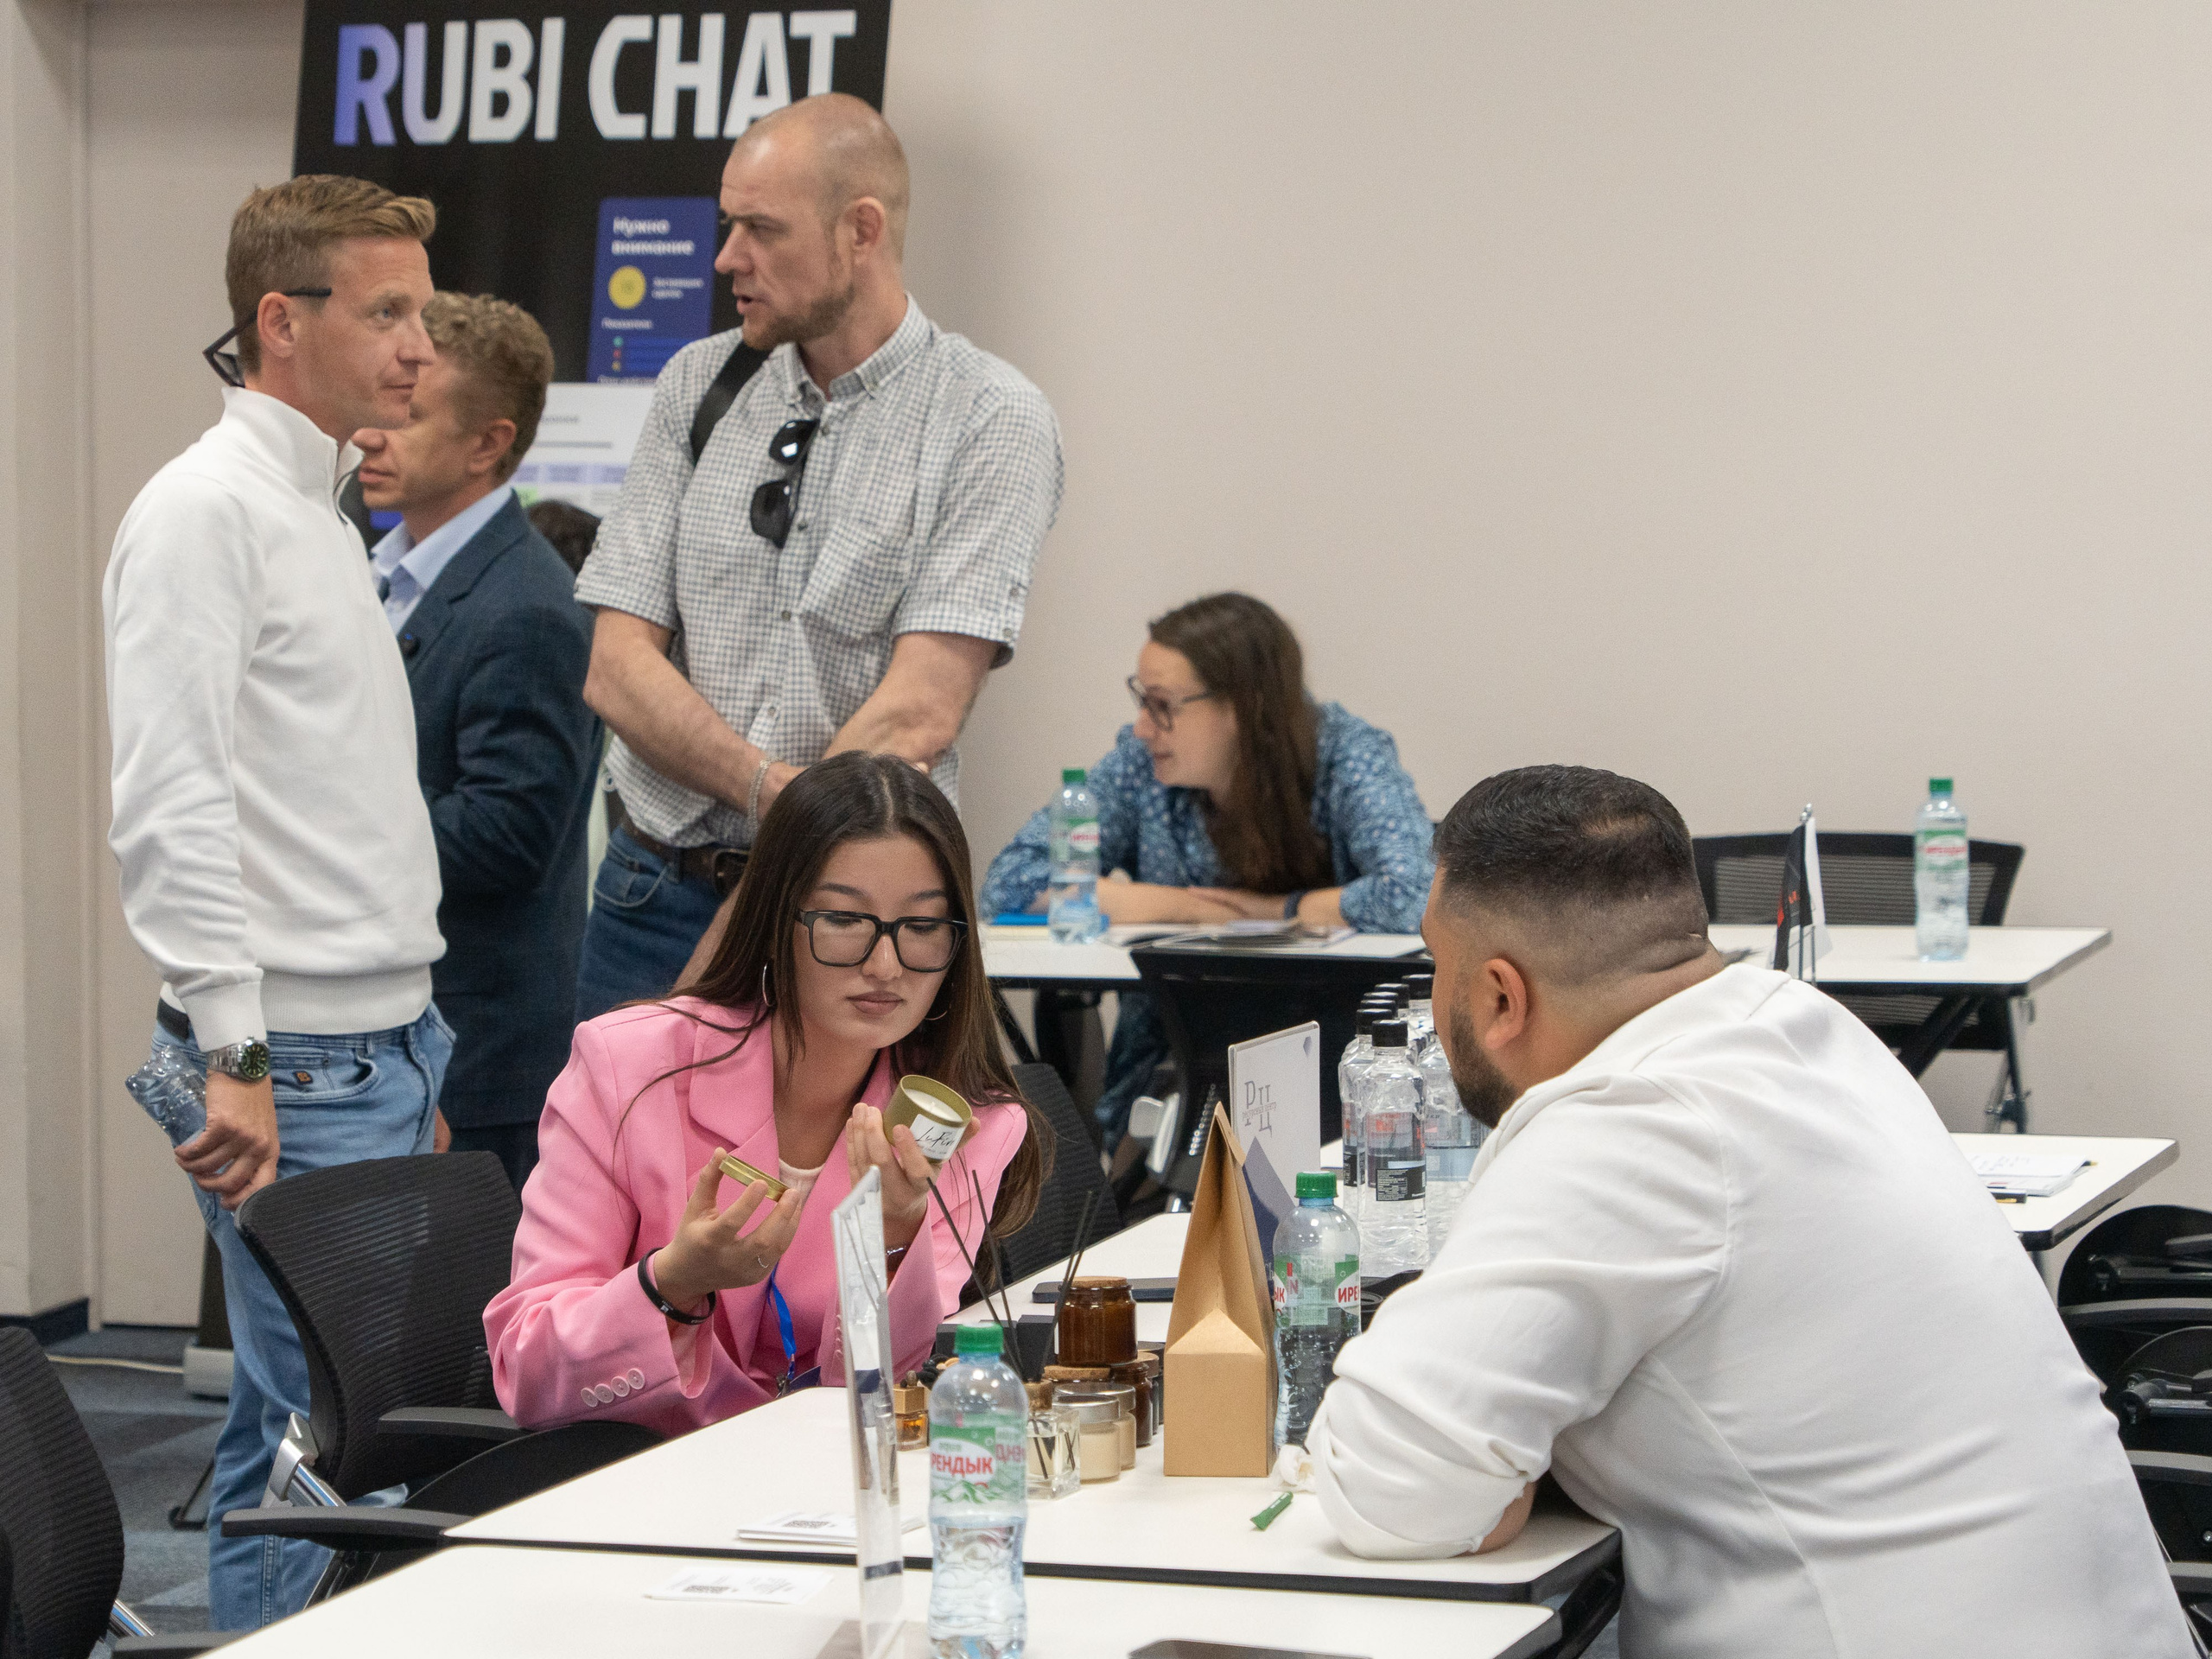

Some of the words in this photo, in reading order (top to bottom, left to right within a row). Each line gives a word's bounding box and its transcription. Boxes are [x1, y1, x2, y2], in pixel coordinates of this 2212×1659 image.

[334, 17, 564, 146] RUBI
[588, 10, 856, 140] CHAT
[1338, 1286, 1359, 1303] ИРЕ
[931, 1452, 994, 1478] РЕНДЫК
